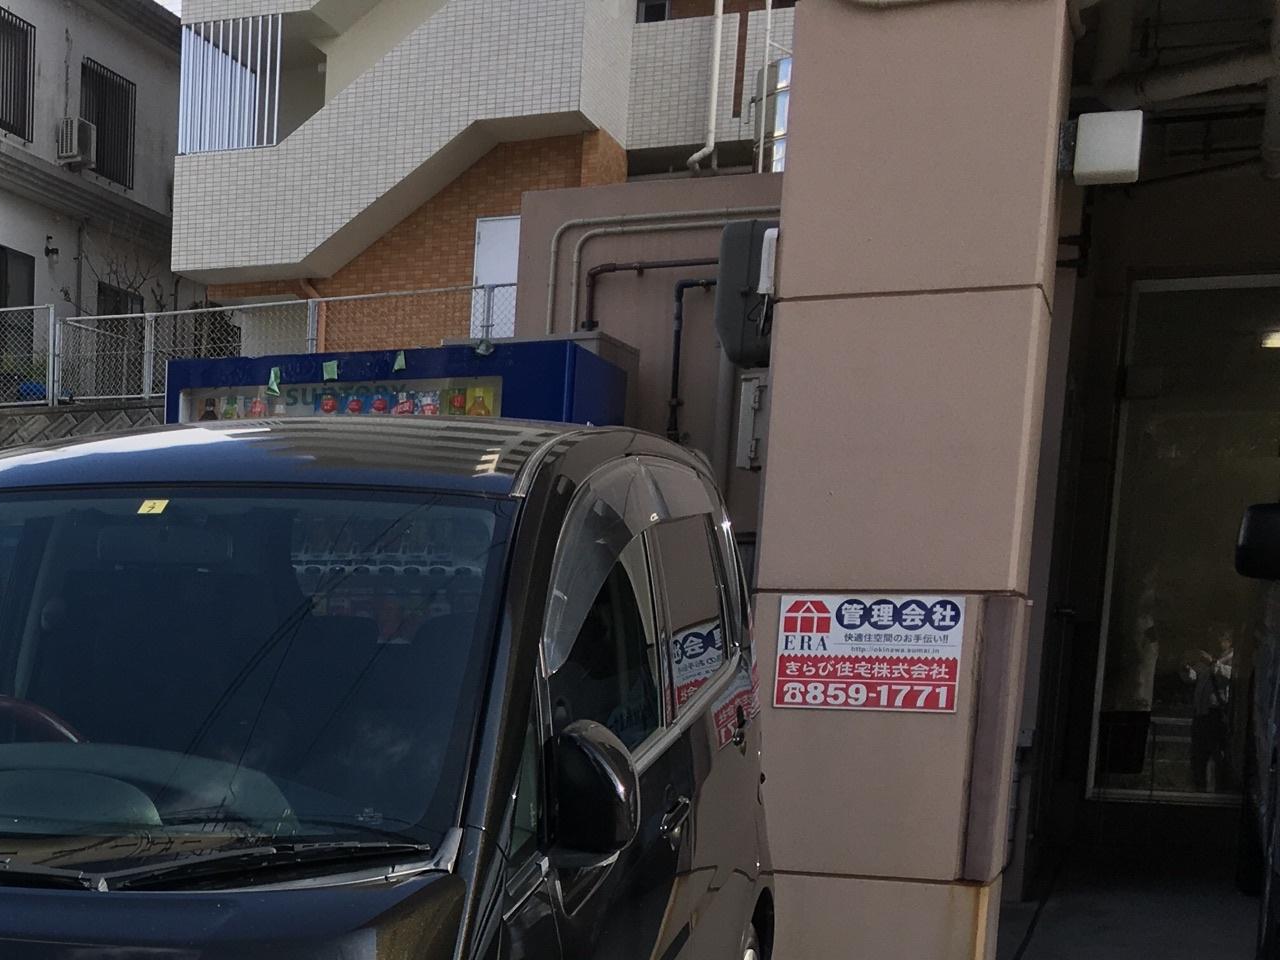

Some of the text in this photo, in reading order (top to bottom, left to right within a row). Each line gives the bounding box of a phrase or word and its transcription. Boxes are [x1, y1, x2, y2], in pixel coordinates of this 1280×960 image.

[840, 602, 957, 627] 管理会社
[783, 635, 829, 651] ERA
[785, 661, 950, 680] きらび住宅株式会社
[805, 683, 949, 709] 859-1771
